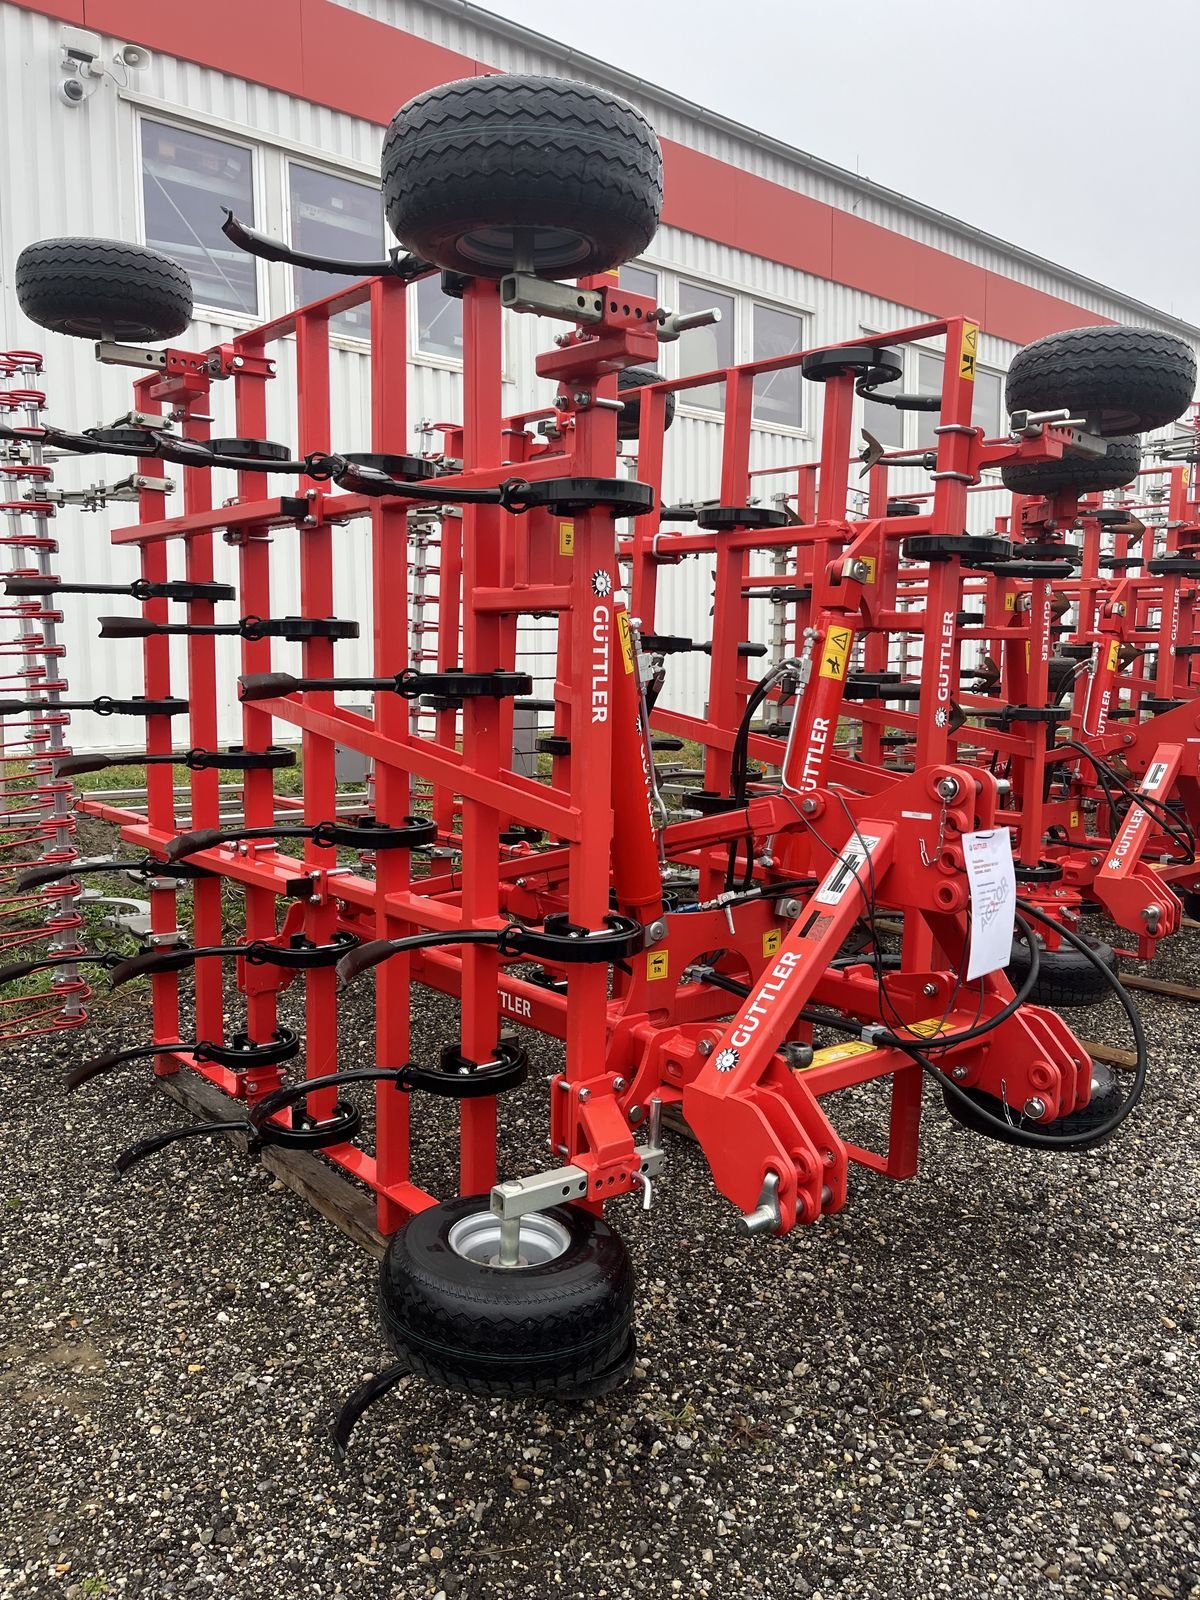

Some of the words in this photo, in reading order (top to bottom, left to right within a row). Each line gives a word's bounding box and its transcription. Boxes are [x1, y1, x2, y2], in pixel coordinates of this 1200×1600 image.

[591, 605, 610, 724] GÜTTLER
[937, 611, 954, 701] GÜTTLER
[799, 717, 830, 792] ÜTTLER
[1114, 808, 1145, 857] GÜTTLER
[730, 951, 803, 1048] GÜTTLER
